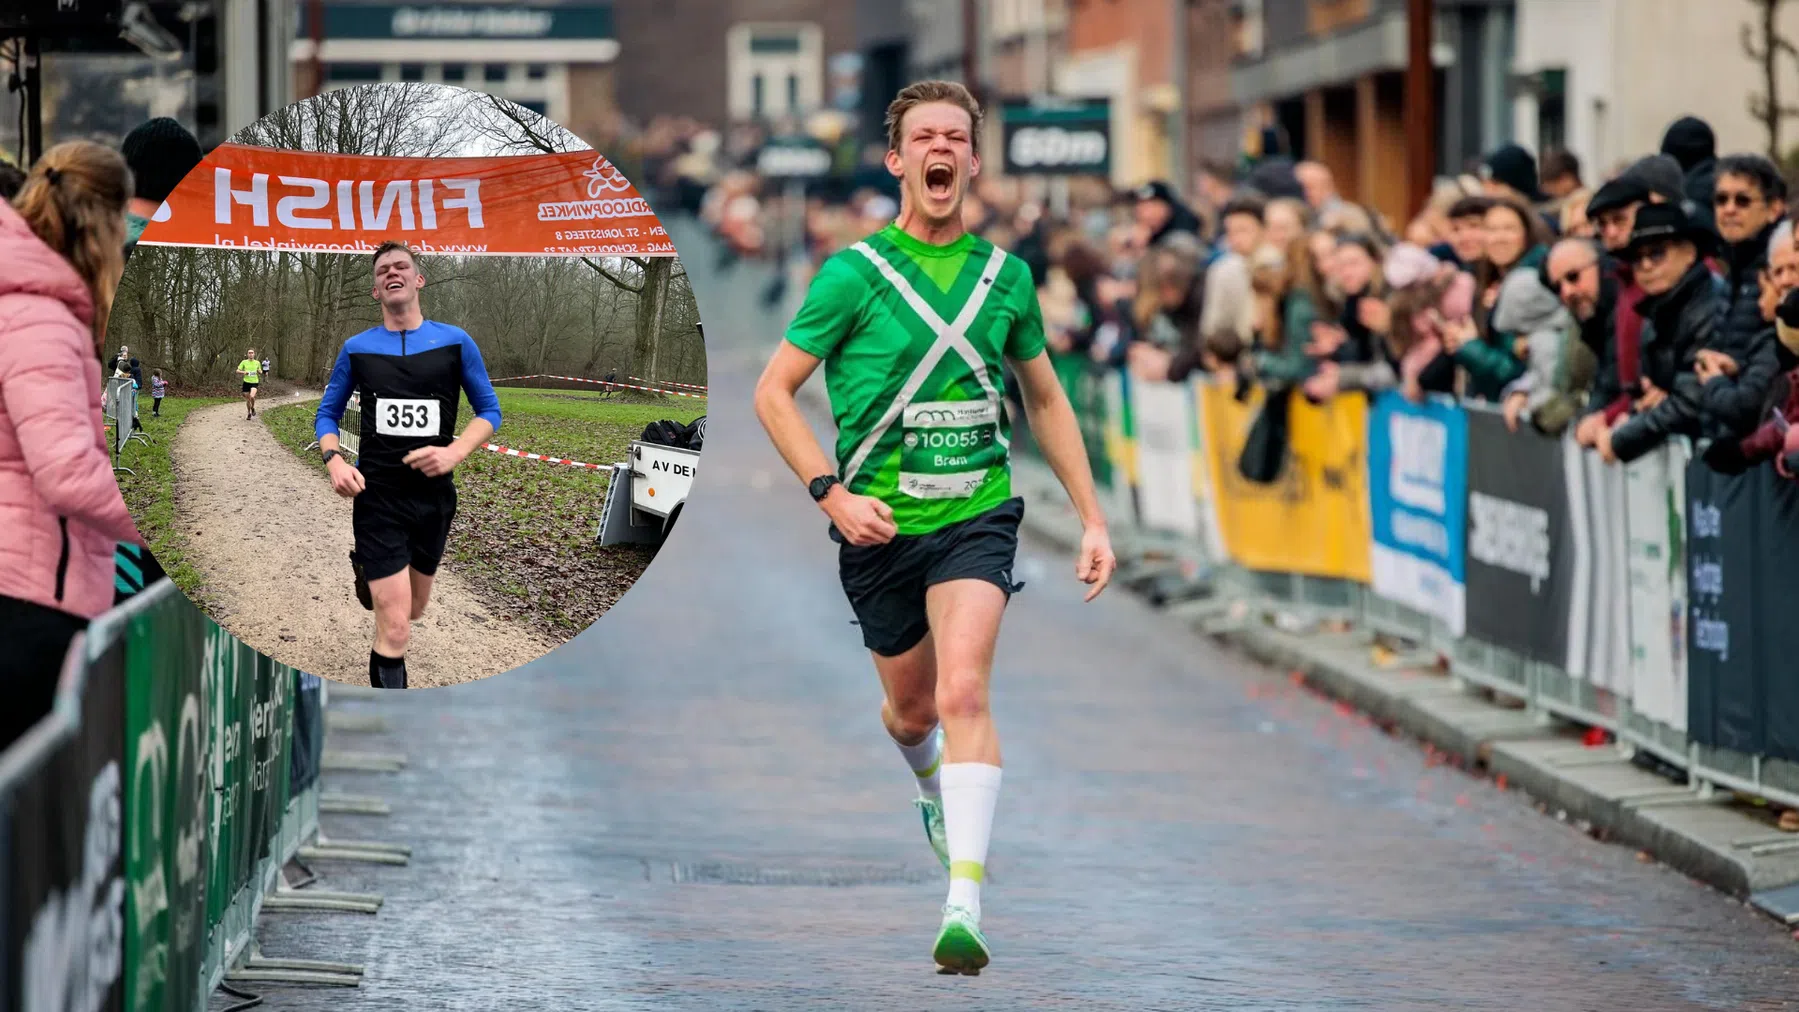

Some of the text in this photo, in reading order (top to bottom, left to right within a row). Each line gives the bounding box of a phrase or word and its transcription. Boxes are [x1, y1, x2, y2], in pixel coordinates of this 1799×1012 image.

[387, 404, 428, 428] 353
[922, 430, 978, 448] 10055
[934, 455, 968, 467] Bram
[673, 463, 689, 477] DE
